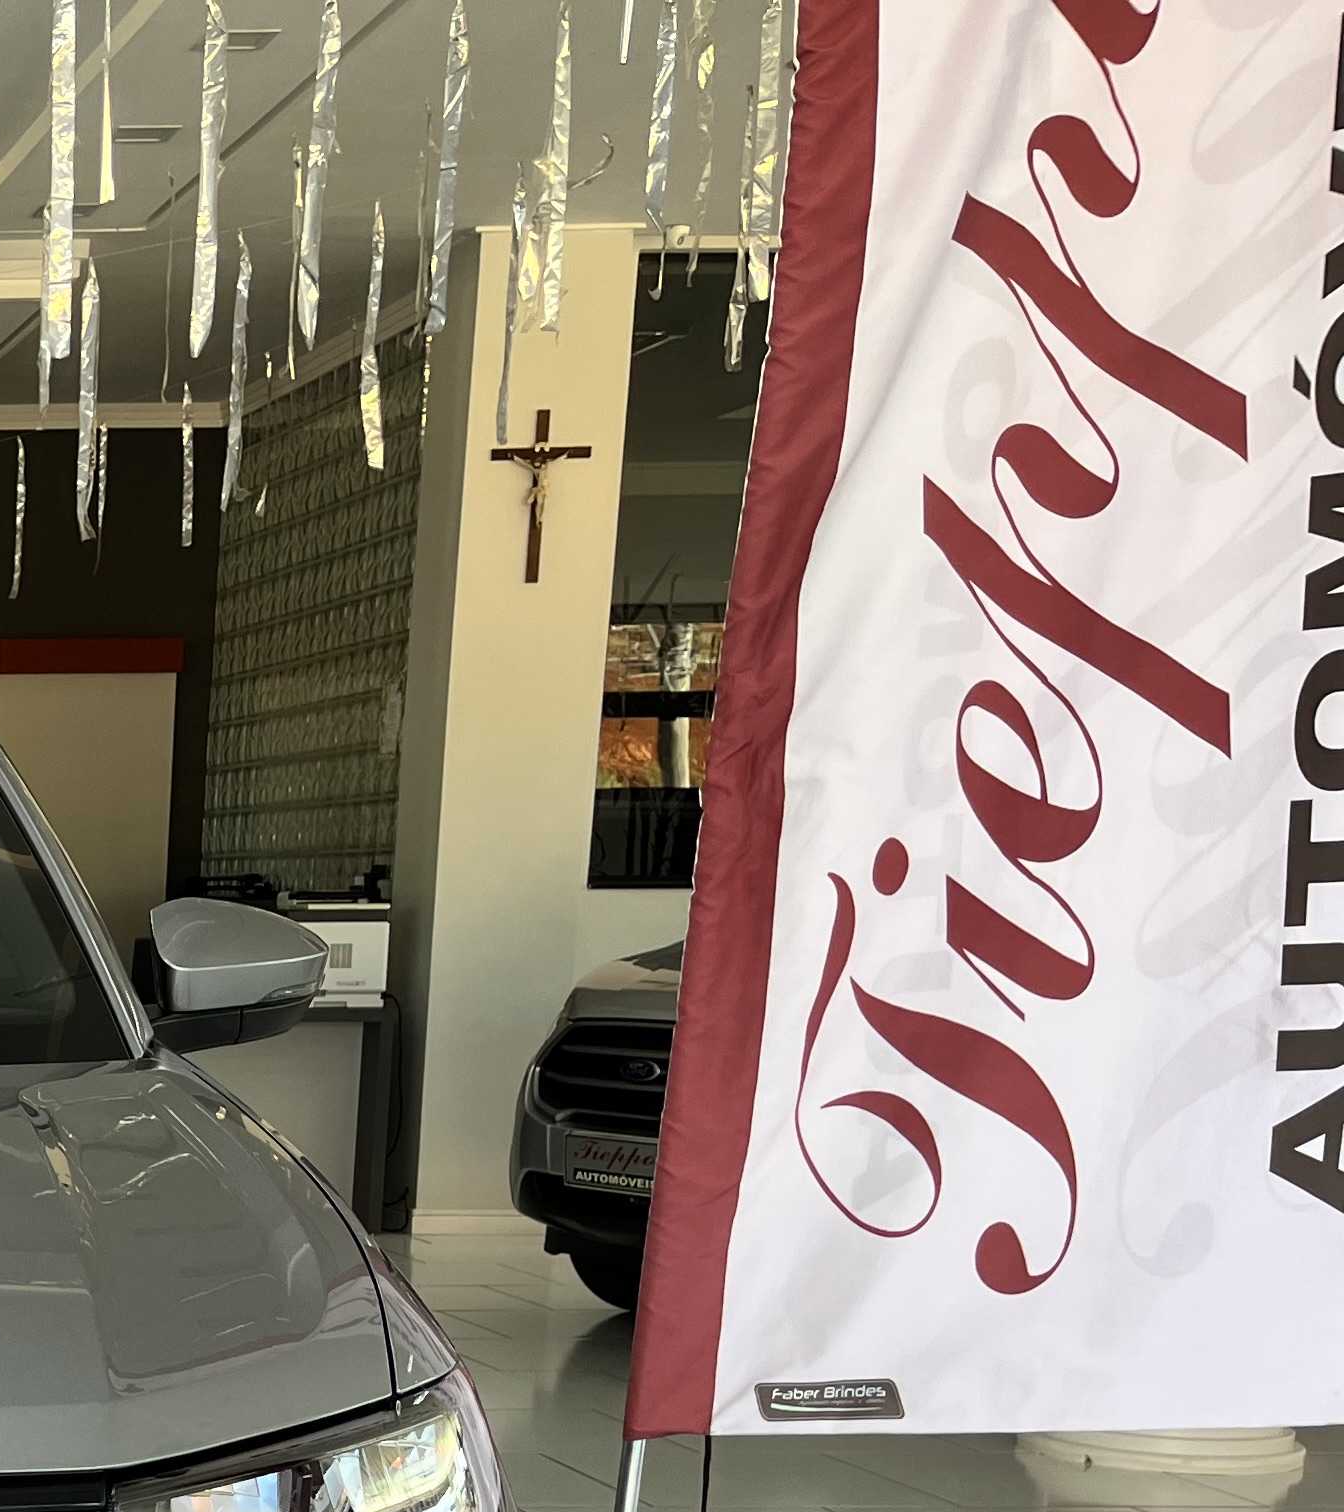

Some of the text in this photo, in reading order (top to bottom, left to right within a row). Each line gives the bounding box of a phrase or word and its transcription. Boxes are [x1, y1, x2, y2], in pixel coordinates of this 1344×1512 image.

[575, 1170, 654, 1190] AUTOMÓVEI
[771, 1384, 886, 1400] Faber Brindes
